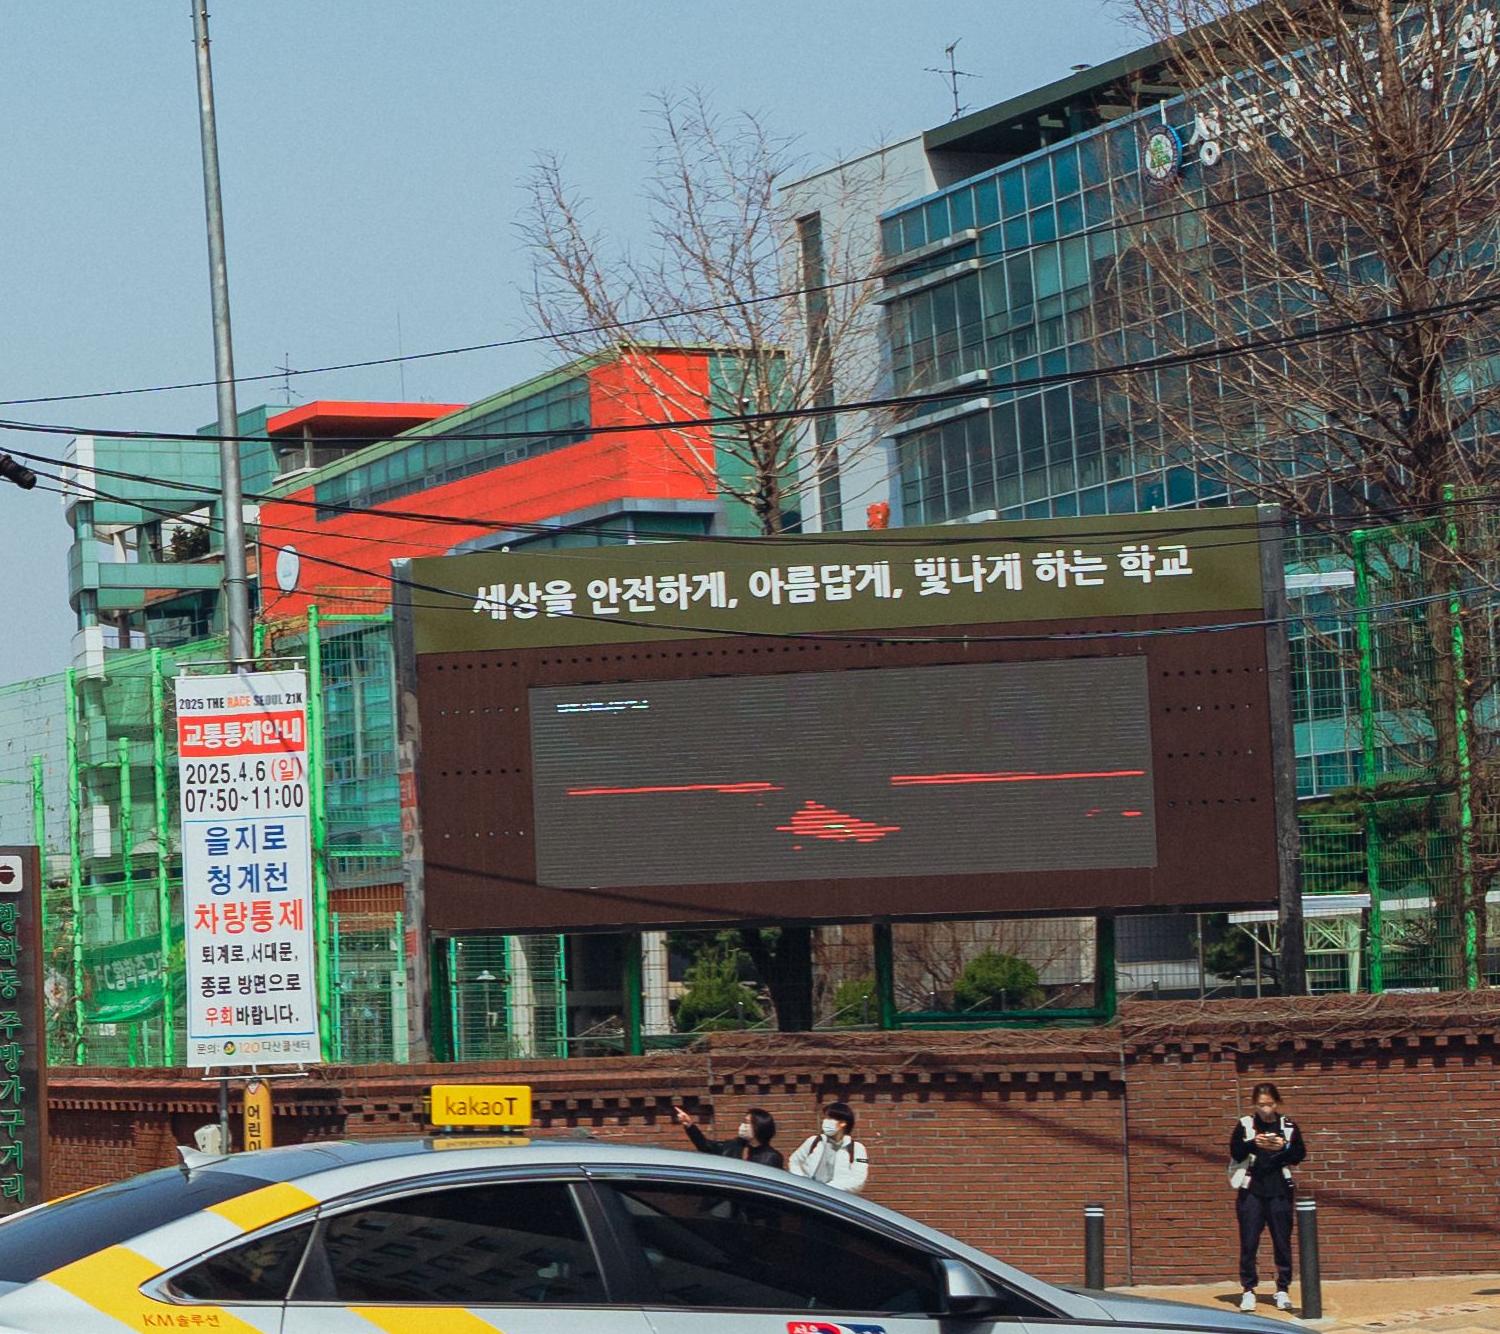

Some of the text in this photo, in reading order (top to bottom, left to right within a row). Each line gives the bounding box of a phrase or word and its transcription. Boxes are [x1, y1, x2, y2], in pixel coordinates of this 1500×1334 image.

[472, 544, 1194, 620] 세상을 안전하게, 아름답게, 빛나게 하는 학교
[179, 692, 303, 710] 2025 THE RACE SEOUL 21K
[182, 717, 301, 749] 교통통제안내
[186, 756, 303, 785] 2025.4.6 (일)
[185, 783, 304, 813] 07:50~11:00
[204, 824, 287, 857] 을지로
[207, 861, 288, 896] 청계천
[194, 898, 304, 935] 차량통제
[200, 973, 302, 998] 종로 방면으로
[196, 1043, 221, 1055] 문의:
[142, 1313, 221, 1328] KM솔루션
